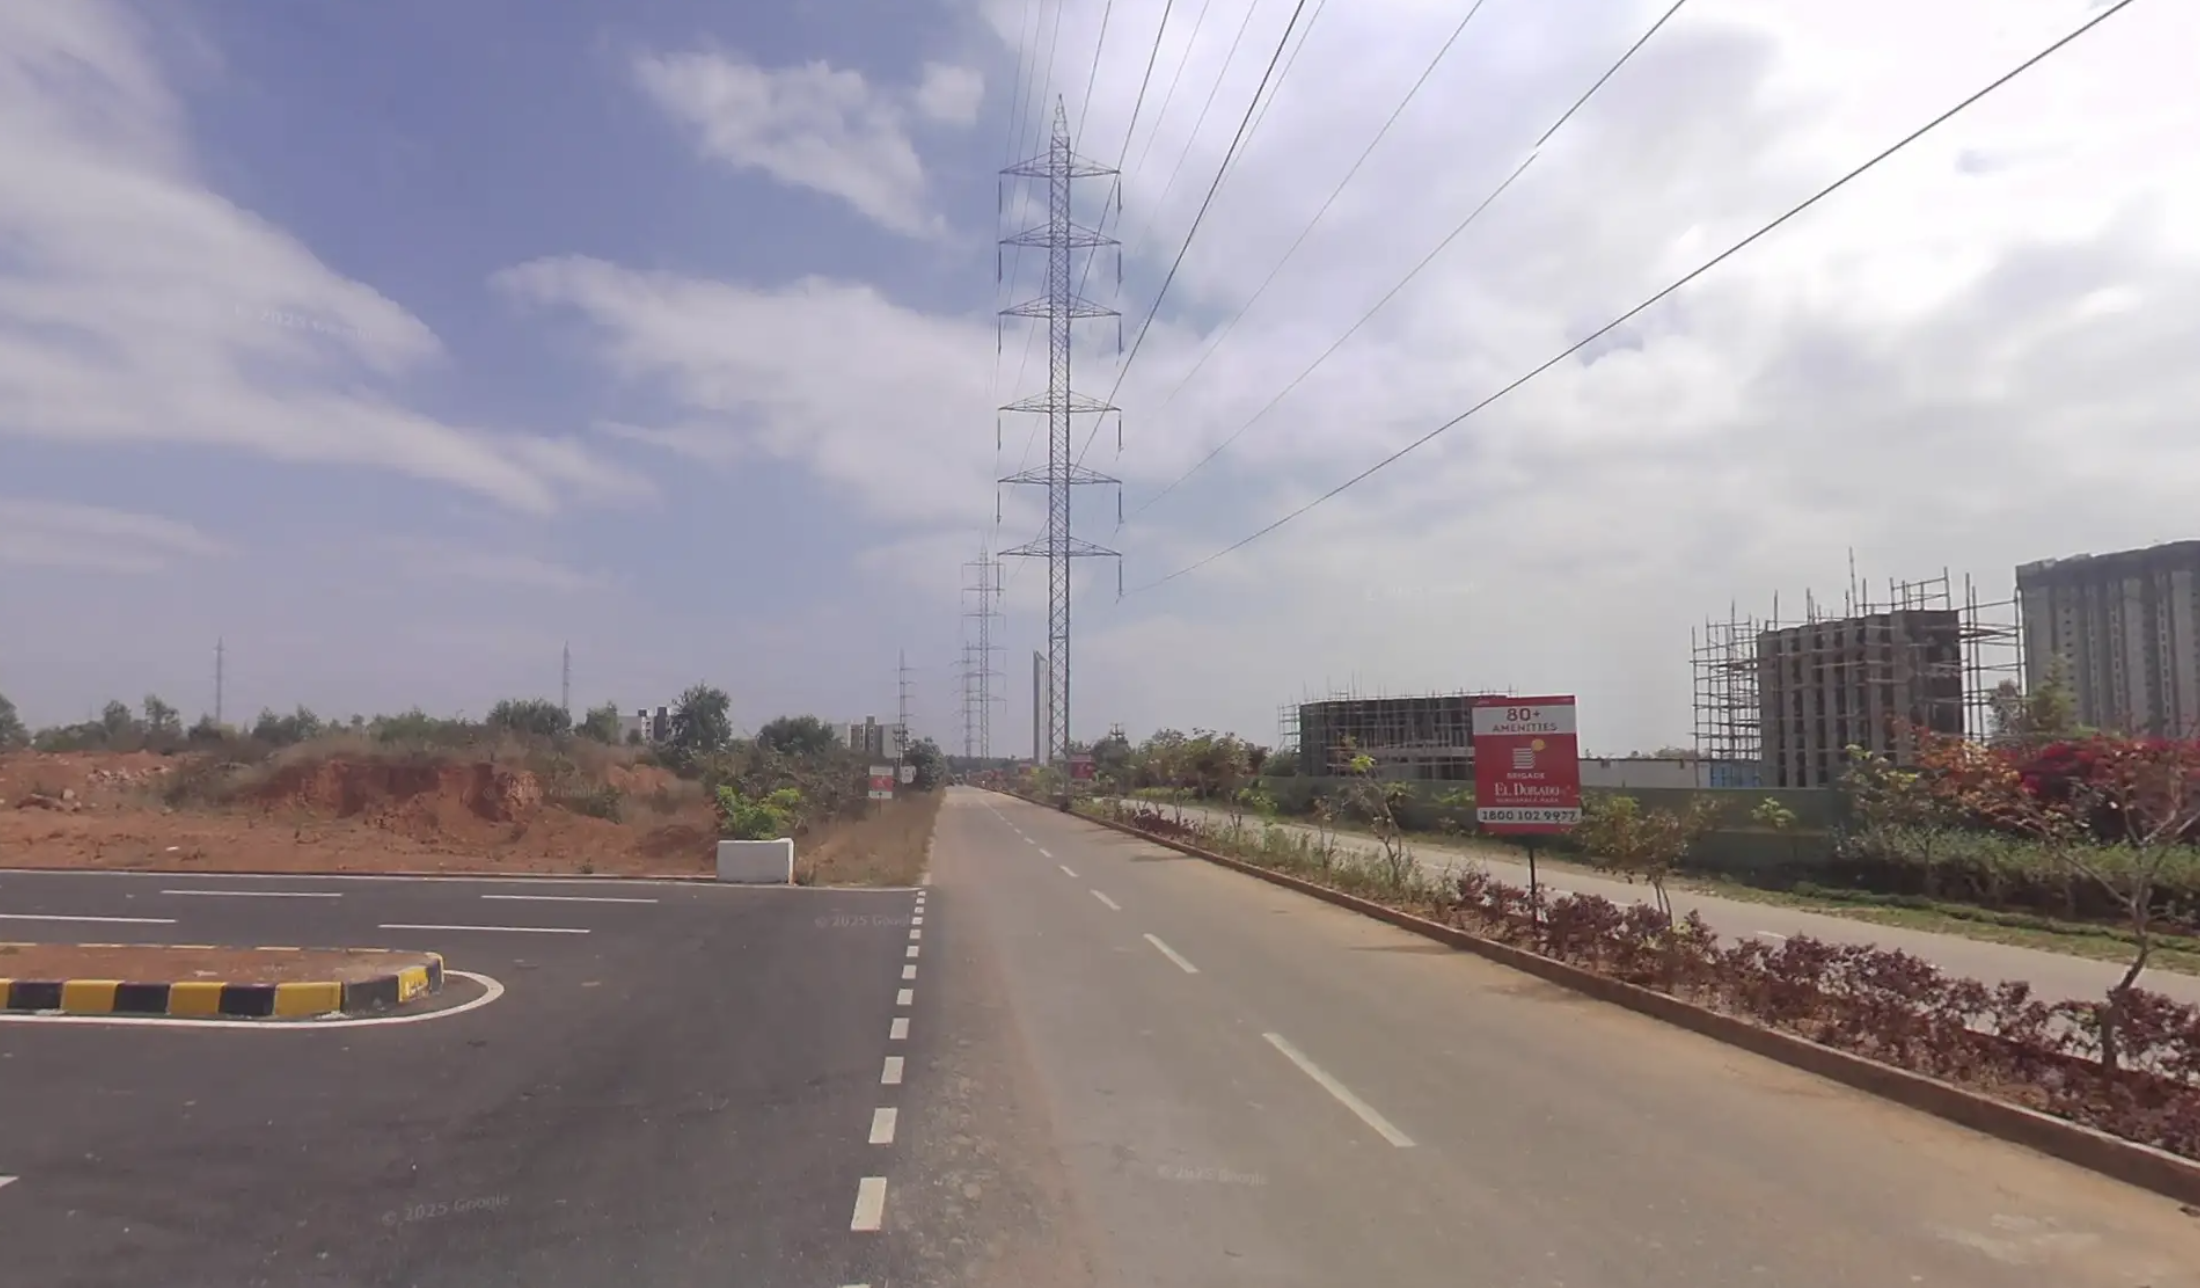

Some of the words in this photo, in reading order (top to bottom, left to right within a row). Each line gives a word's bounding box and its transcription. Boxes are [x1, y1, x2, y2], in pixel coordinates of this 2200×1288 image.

[1506, 707, 1541, 722] 80+
[1492, 722, 1558, 733] AMENITIES
[1506, 772, 1546, 780] BRIGADE
[1494, 782, 1512, 797] EL
[1513, 782, 1560, 797] DORADO
[1482, 810, 1514, 821] 1800
[1517, 810, 1541, 821] 102
